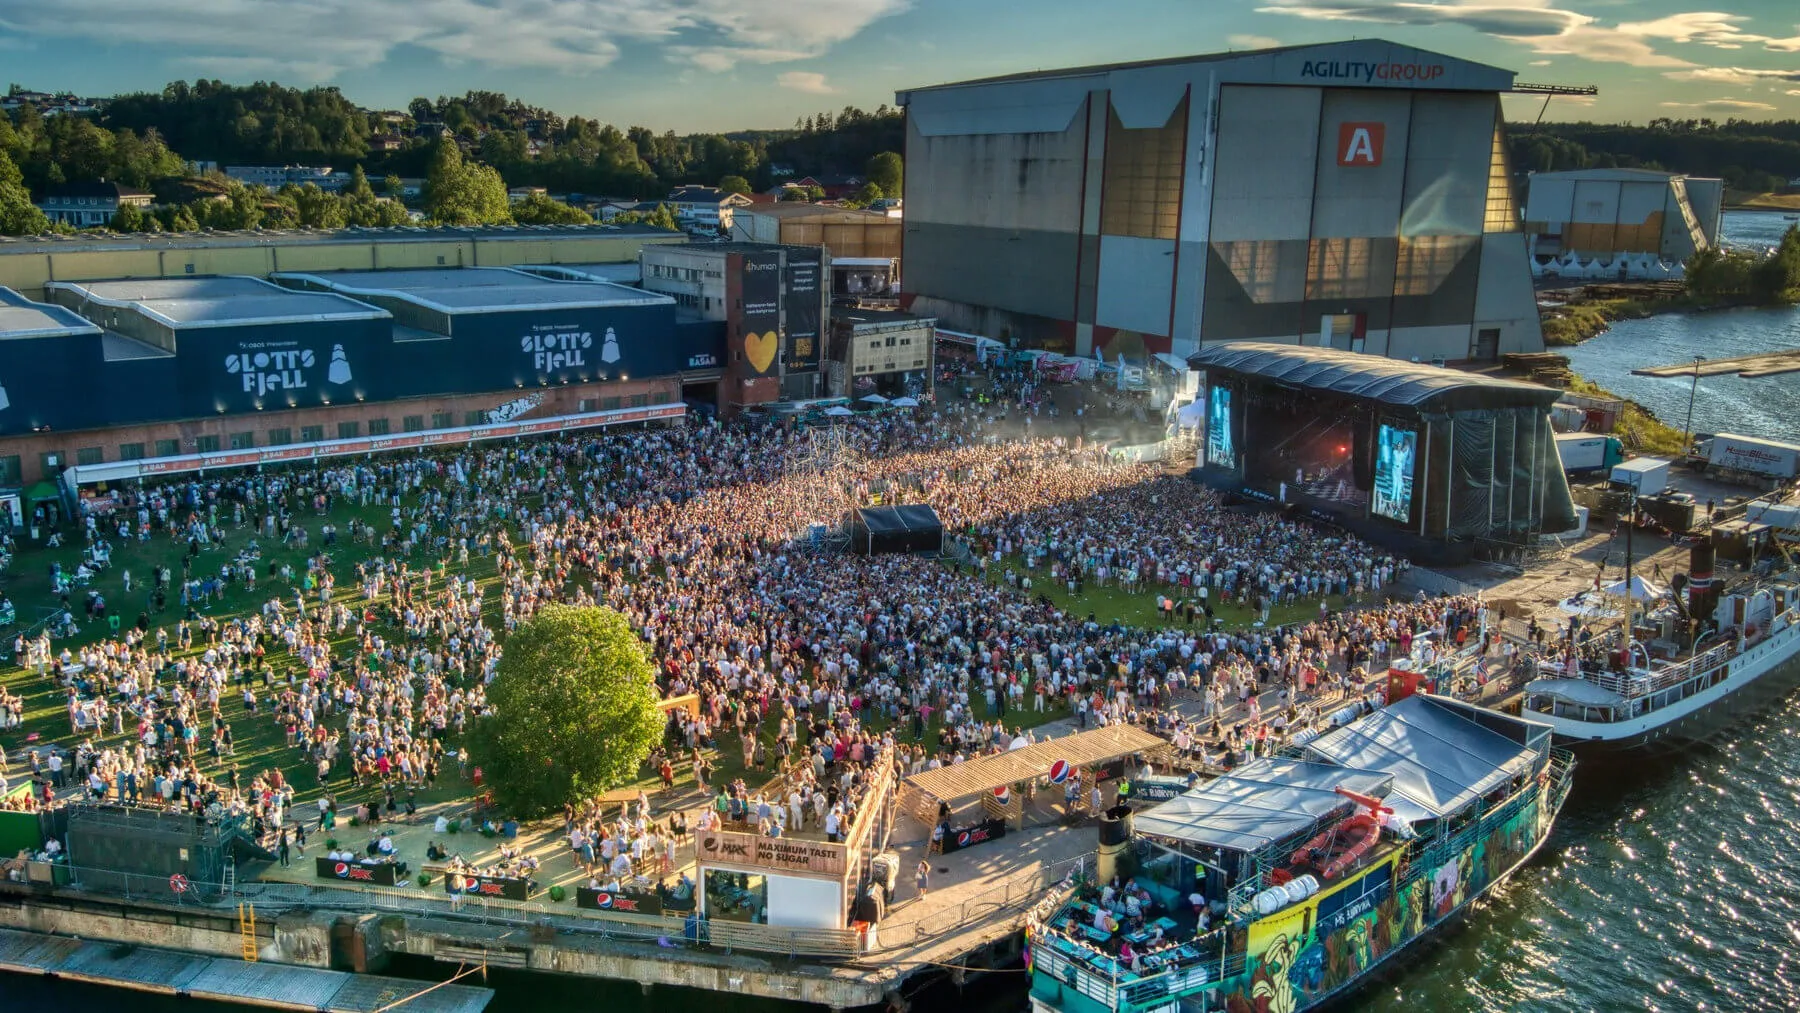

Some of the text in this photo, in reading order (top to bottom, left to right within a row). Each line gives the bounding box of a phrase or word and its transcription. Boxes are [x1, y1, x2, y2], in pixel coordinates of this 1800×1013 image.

[1301, 60, 1445, 83] AGILITYGROUP
[1344, 128, 1375, 162] A
[521, 332, 592, 352] SLOTTS
[225, 349, 316, 374] SLOTTS
[758, 843, 837, 859] MAXIMUM TASTE
[758, 851, 809, 864] NO SUGAR
